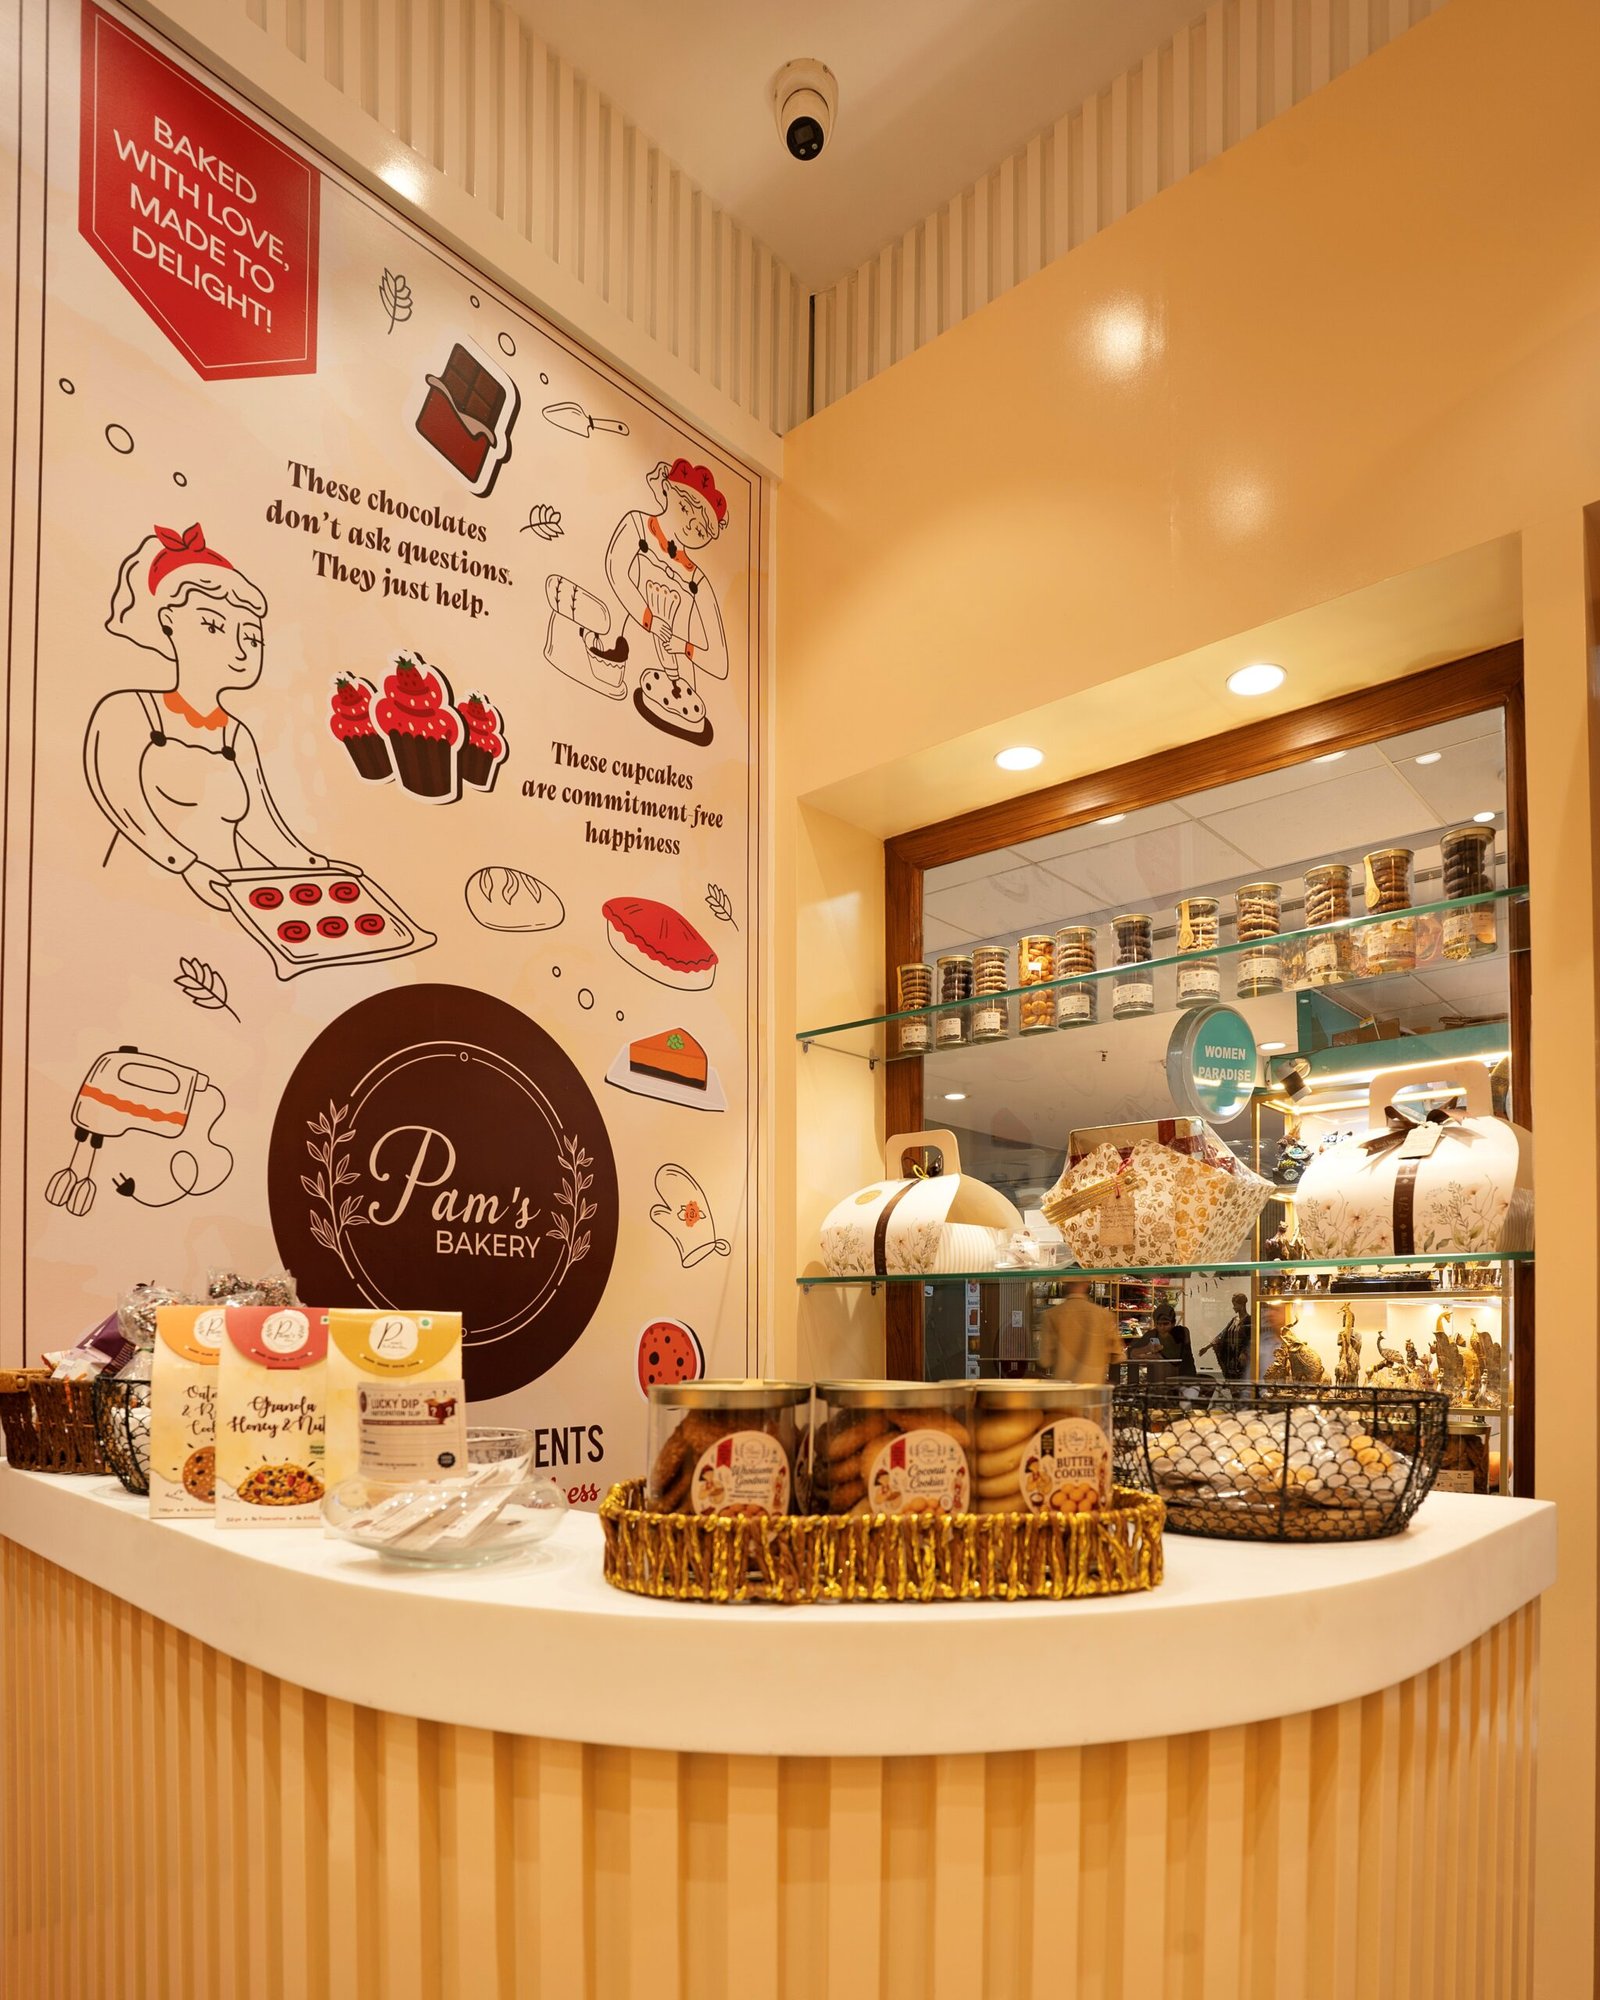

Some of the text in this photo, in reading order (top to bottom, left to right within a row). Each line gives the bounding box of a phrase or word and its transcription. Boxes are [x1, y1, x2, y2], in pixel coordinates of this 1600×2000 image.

[154, 115, 257, 204] BAKED
[113, 128, 290, 272] WITH LOVE,
[131, 182, 275, 293] MADE TO
[133, 225, 272, 334] DELIGHT!
[287, 460, 487, 542] These chocolates
[266, 500, 513, 586] don’t ask questions.
[312, 549, 489, 619] They just help.
[551, 741, 693, 790] These cupcakes
[522, 779, 557, 800] are
[585, 821, 680, 855] happiness
[1204, 1045, 1246, 1060] WOMEN
[1198, 1066, 1251, 1081] PARADISE
[368, 1125, 541, 1229] Pam's
[436, 1230, 540, 1258] BAKERY
[247, 1396, 316, 1418] Granola
[371, 1399, 419, 1409] LUCKY DIP
[227, 1416, 277, 1438] Honey
[282, 1418, 292, 1432] &
[535, 1424, 604, 1468] ENTS
[1054, 1467, 1096, 1480] COOKIES
[1057, 1456, 1094, 1469] BUTTER
[567, 1483, 601, 1504] ess
[909, 1475, 944, 1489] Cookies
